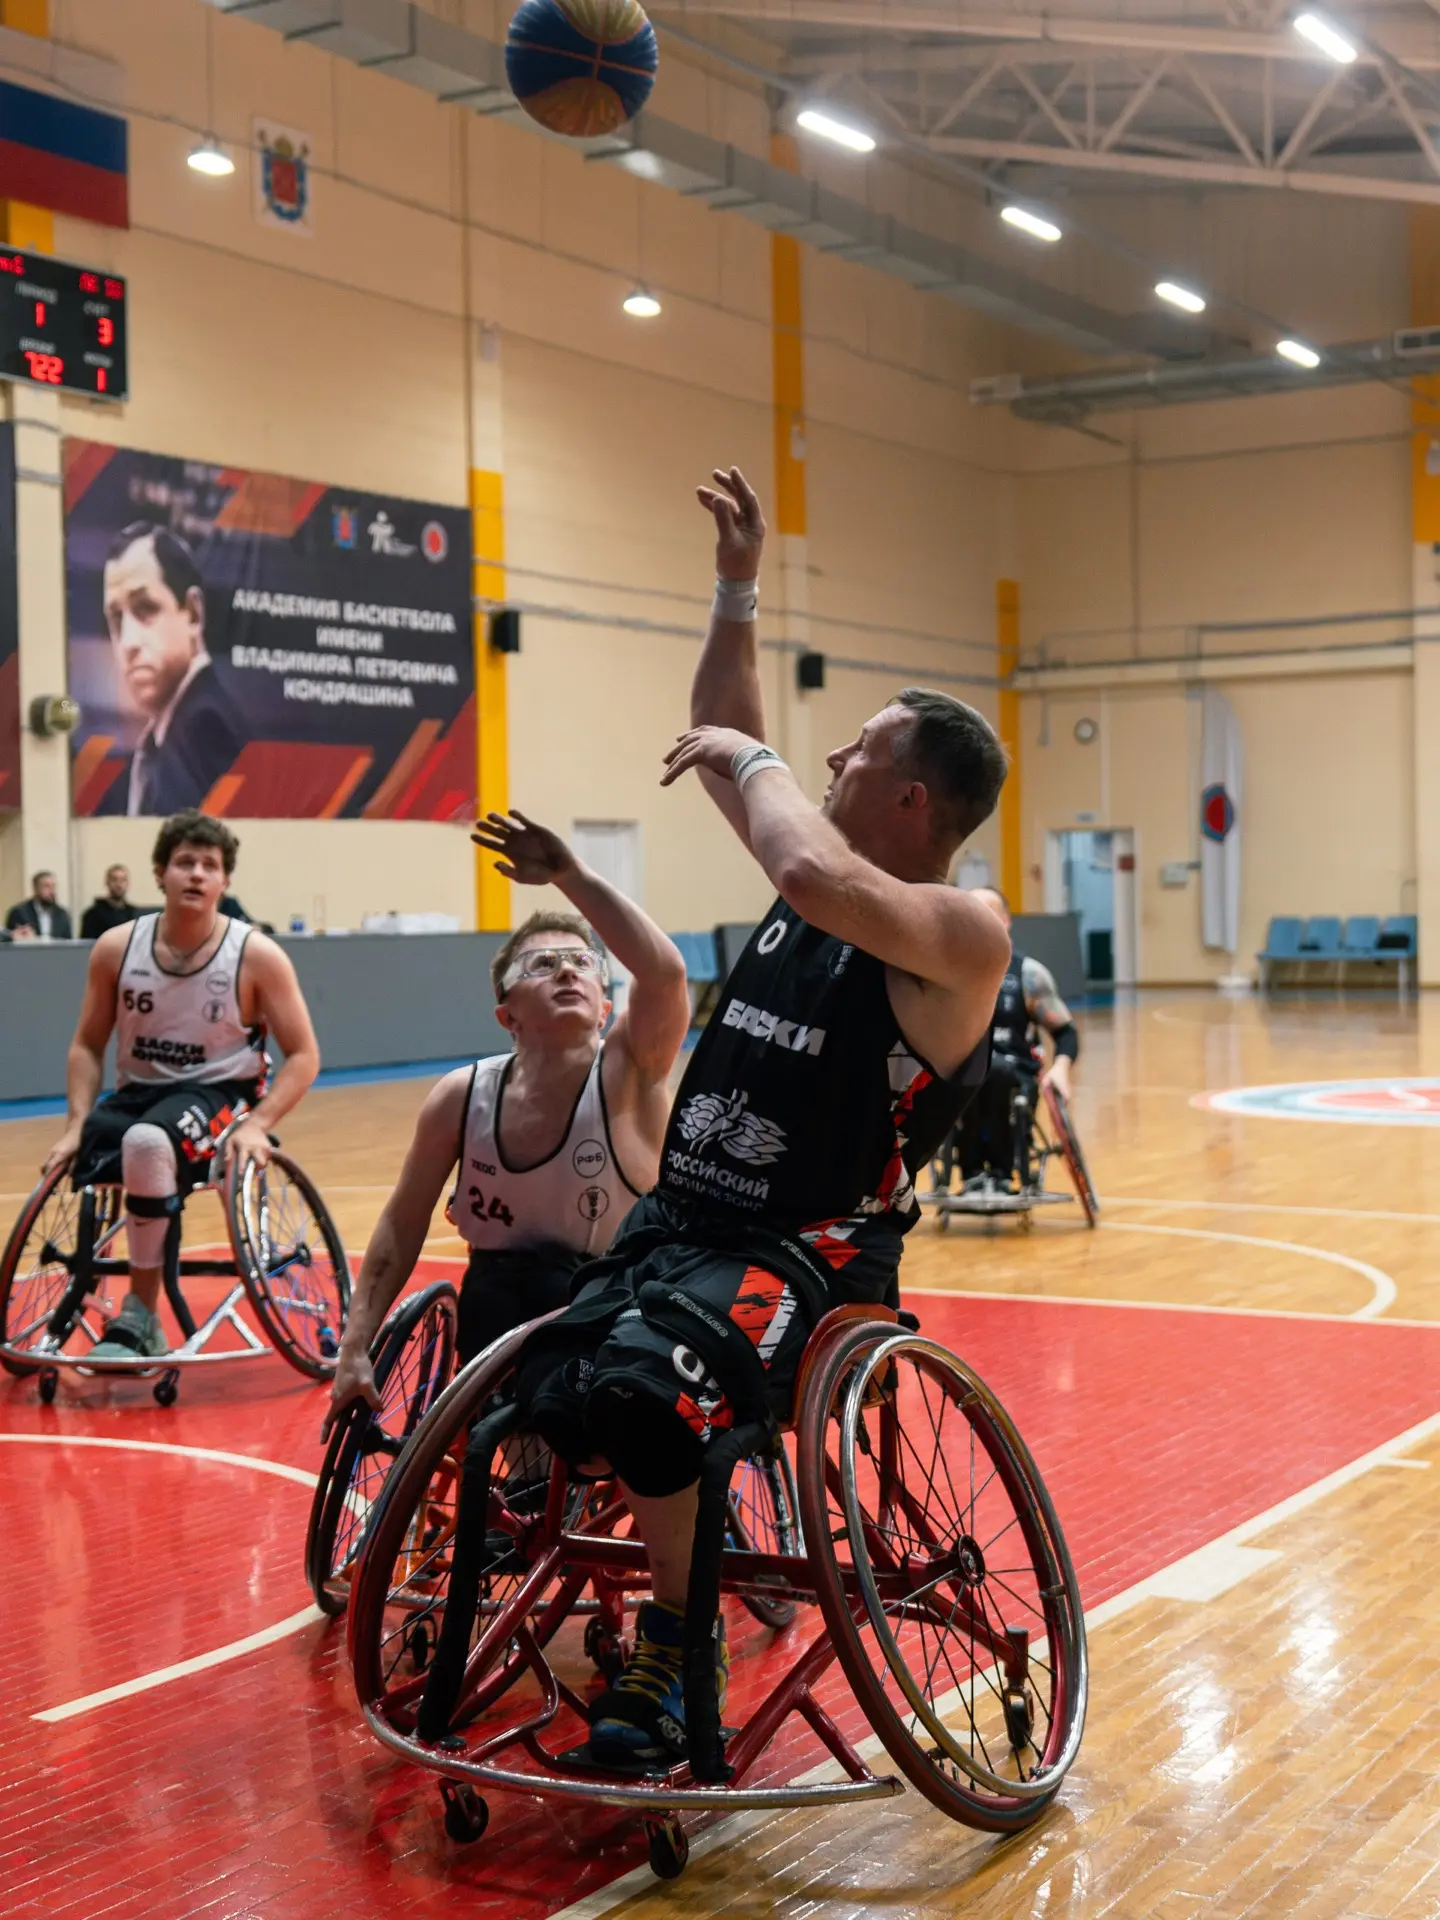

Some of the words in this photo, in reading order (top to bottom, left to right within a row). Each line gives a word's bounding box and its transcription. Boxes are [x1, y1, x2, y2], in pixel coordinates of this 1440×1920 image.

[35, 301, 45, 327] 1
[97, 317, 114, 347] 3
[97, 367, 107, 392] 1
[232, 588, 341, 621] АКАДЕМИЯ
[343, 601, 457, 633] БАСКЕТБОЛА
[316, 626, 384, 652] ИМЕНИ
[231, 645, 352, 676] ВЛАДИМИРА
[354, 656, 459, 685] ПЕТРОВИЧА
[283, 677, 415, 707] КОНДРАШИНА
[123, 989, 154, 1014] 66
[468, 1185, 514, 1227] 24
